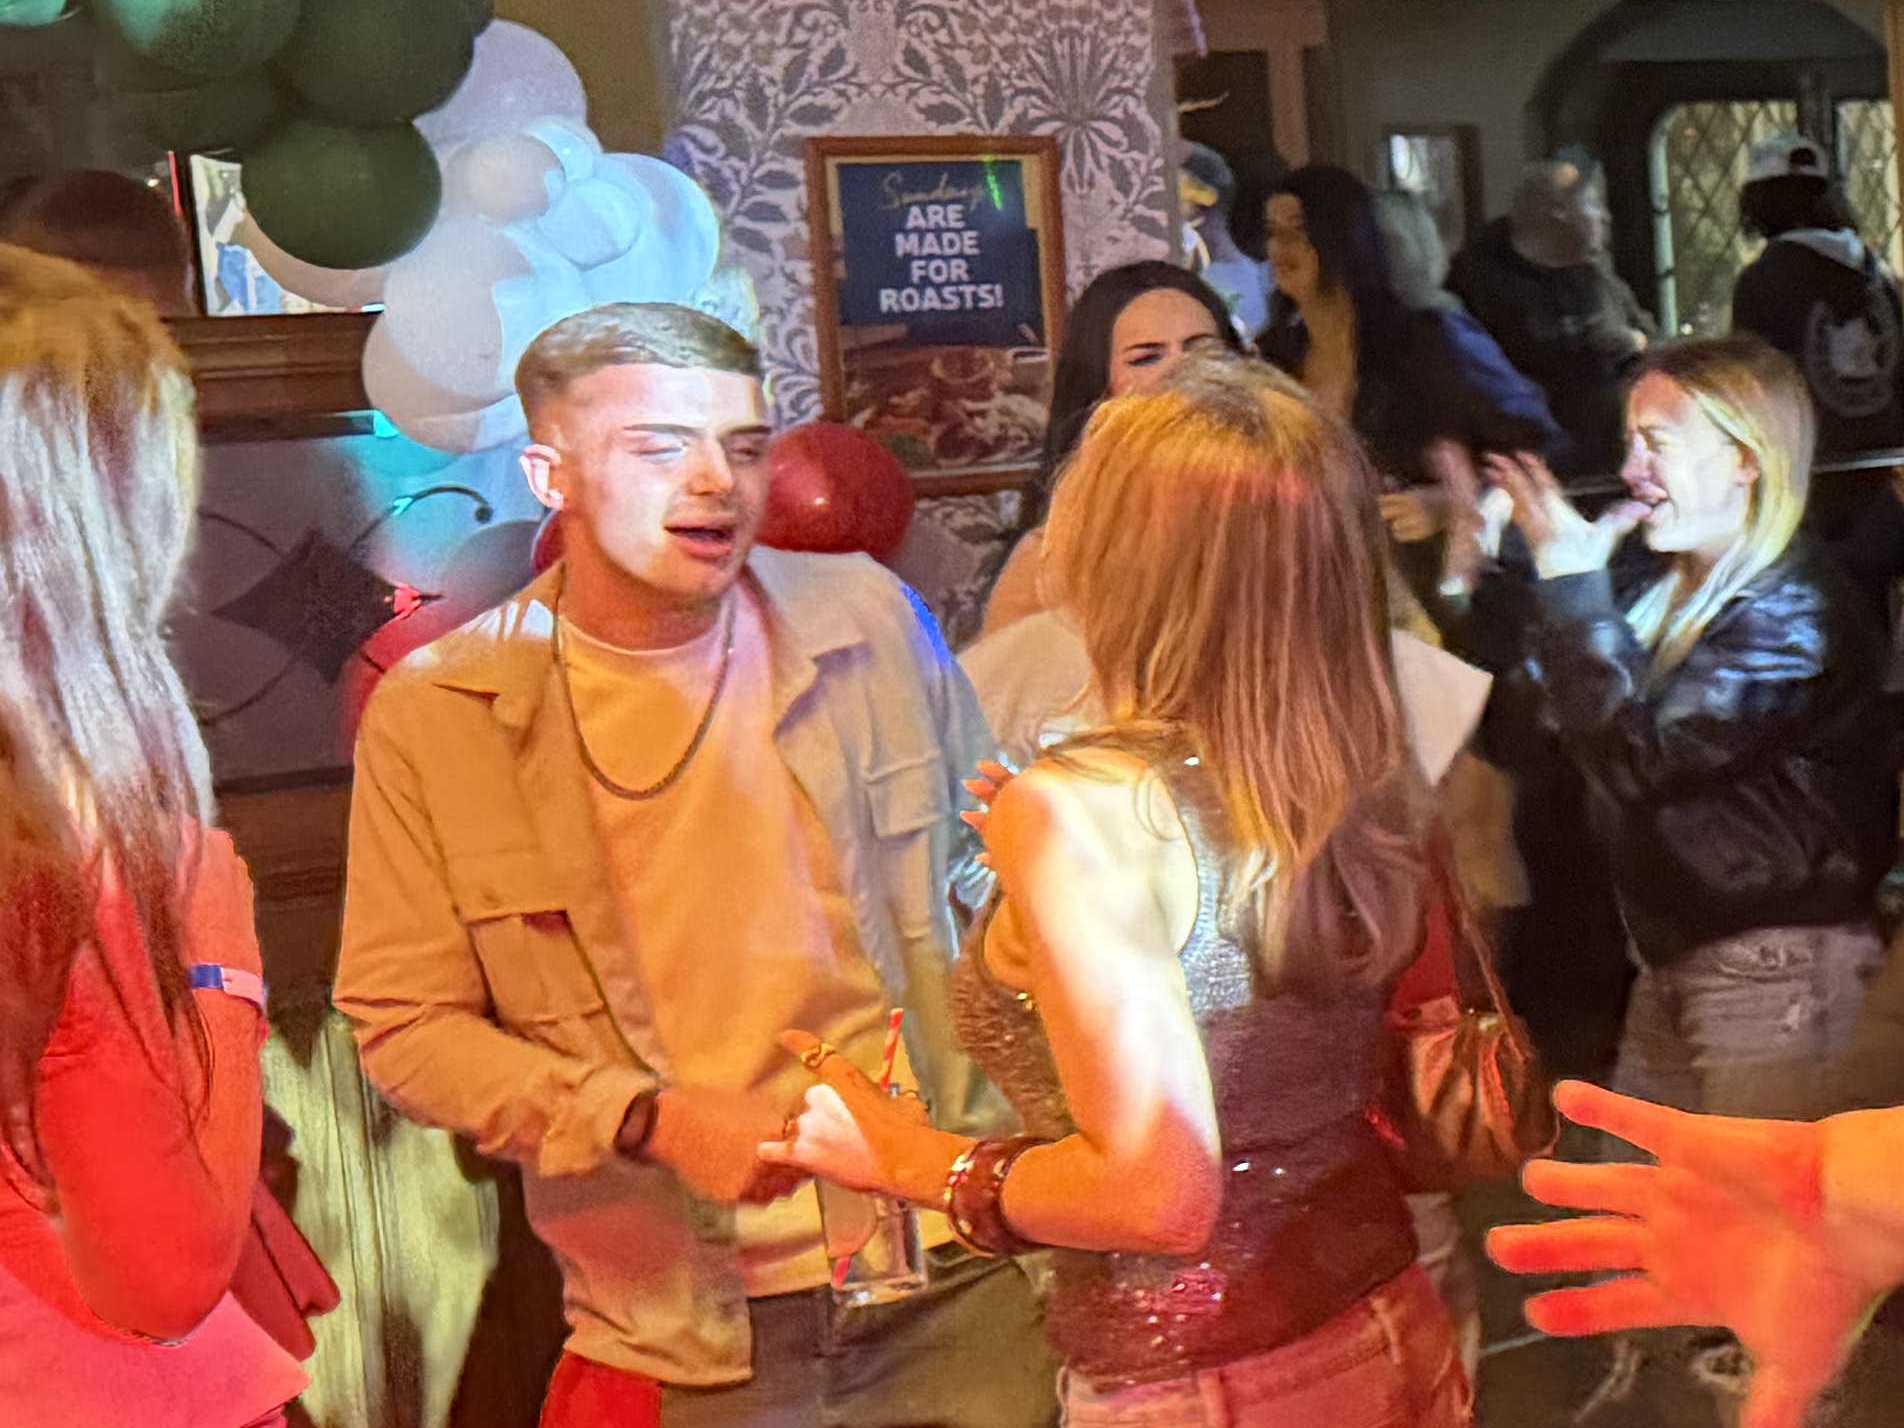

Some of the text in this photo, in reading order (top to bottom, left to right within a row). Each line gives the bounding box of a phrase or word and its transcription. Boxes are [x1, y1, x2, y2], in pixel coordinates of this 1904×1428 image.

[906, 204, 965, 229] ARE
[894, 231, 980, 258] MADE
[910, 258, 970, 285] FOR
[879, 283, 1004, 313] ROASTS!
